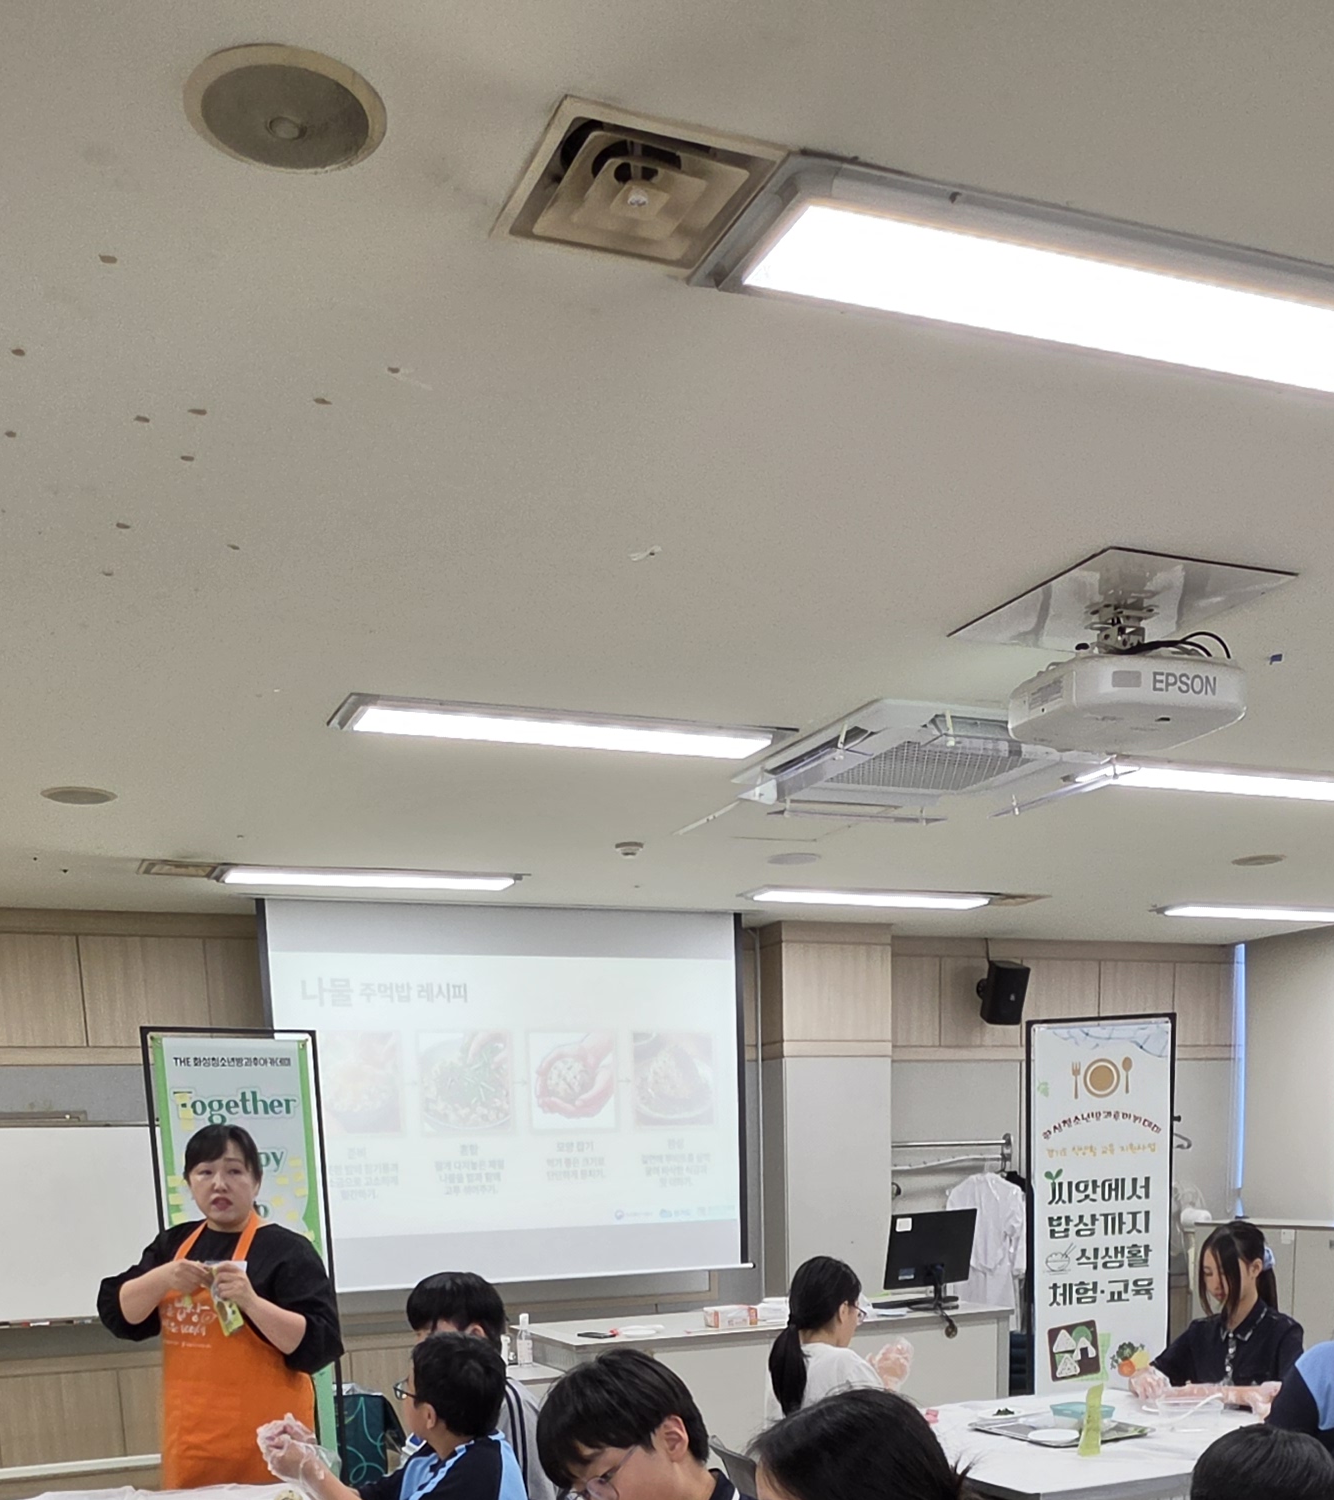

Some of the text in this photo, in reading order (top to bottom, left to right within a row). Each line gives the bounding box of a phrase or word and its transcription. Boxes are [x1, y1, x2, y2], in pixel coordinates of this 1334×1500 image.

[1152, 671, 1217, 696] EPSON
[300, 977, 468, 1007] 나물 주먹밥 레시피
[173, 1057, 191, 1067] THE
[1047, 1176, 1151, 1205] 씨앗에서
[1047, 1210, 1151, 1239] 밥상까지
[1075, 1244, 1153, 1270] 식생활
[1048, 1277, 1155, 1307] 체험·교육
